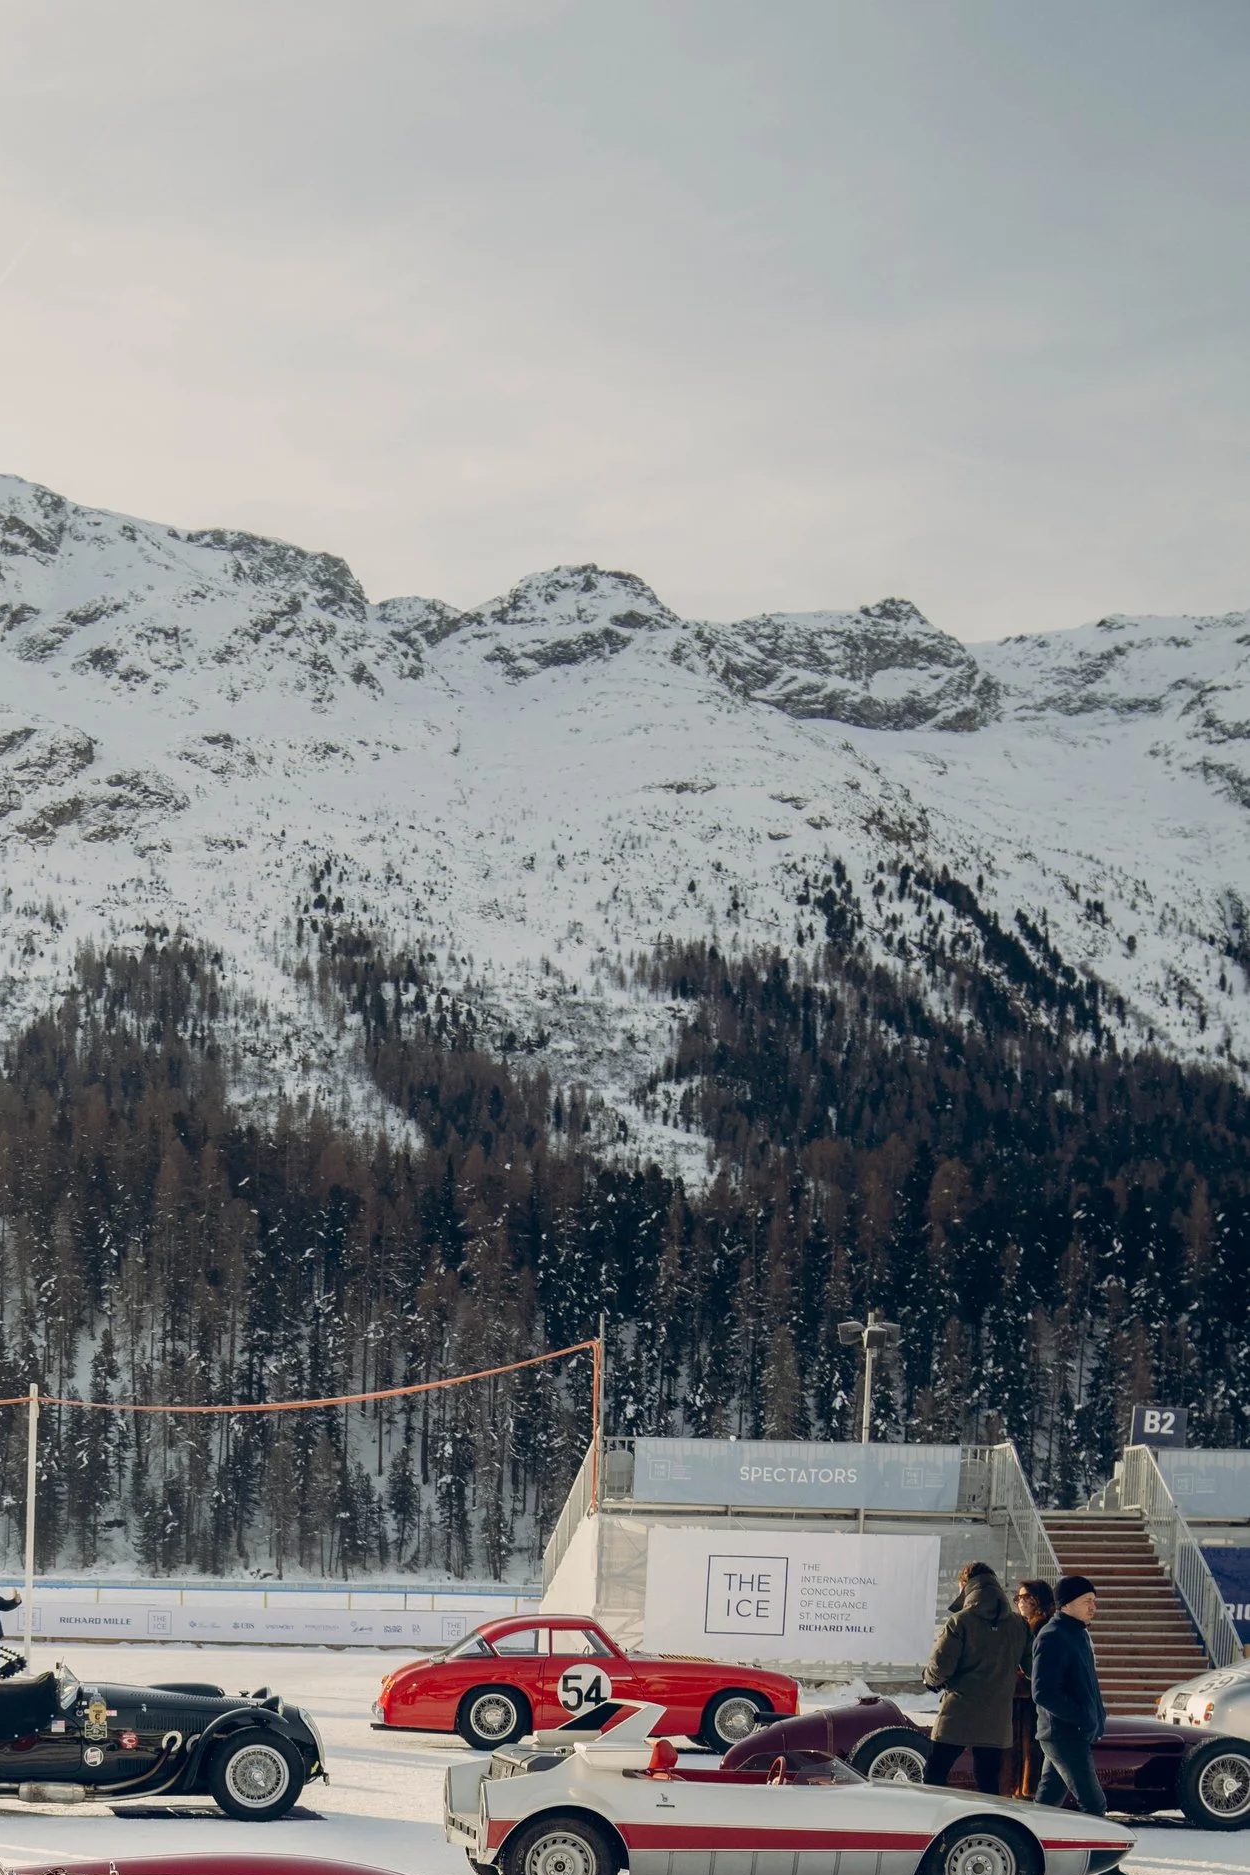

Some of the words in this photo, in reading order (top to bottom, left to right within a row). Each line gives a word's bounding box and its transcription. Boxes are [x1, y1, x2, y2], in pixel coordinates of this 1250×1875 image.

[1143, 1410, 1176, 1434] B2
[739, 1466, 858, 1484] SPECTATORS
[802, 1563, 821, 1571] THE
[723, 1573, 772, 1593] THE
[801, 1575, 878, 1586] INTERNATIONAL
[800, 1587, 856, 1597] CONCOURS
[726, 1599, 770, 1618] ICE
[800, 1600, 814, 1608] OF
[816, 1600, 868, 1610] ELEGANCE
[59, 1616, 101, 1624] RICHARD
[103, 1617, 132, 1625] MILLE
[799, 1612, 812, 1620] ST.
[814, 1612, 851, 1622] MORITZ
[798, 1624, 843, 1633] RICHARD
[845, 1625, 876, 1634] MILLE
[561, 1674, 608, 1712] 54
